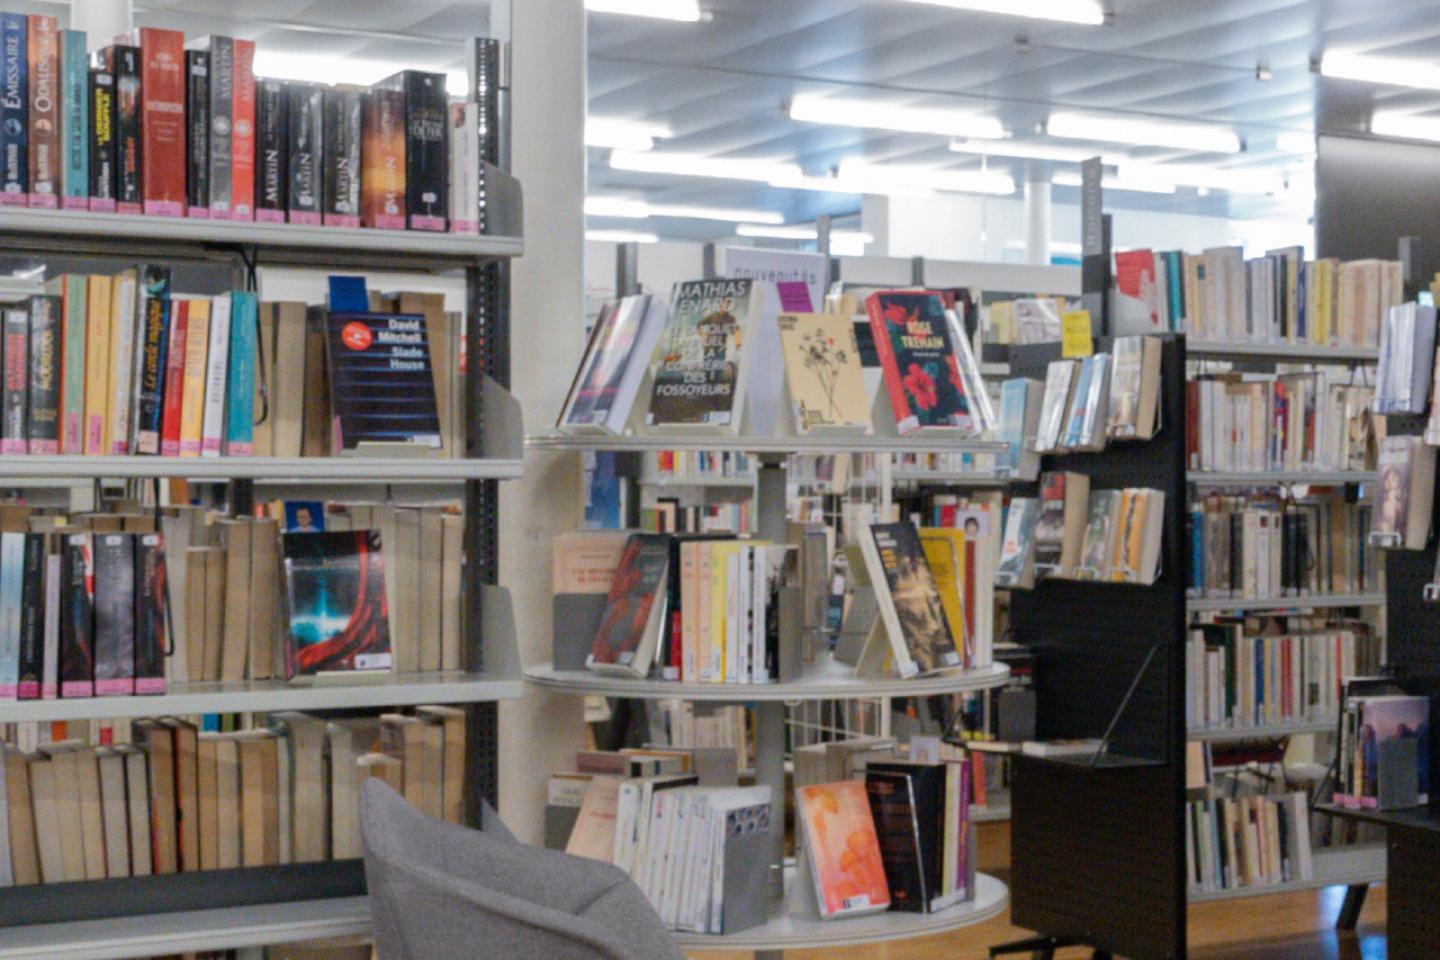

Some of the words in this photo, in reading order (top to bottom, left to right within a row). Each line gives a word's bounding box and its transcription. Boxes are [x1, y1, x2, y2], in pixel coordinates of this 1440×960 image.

[0, 36, 20, 109] ÉMISSAIRE
[265, 150, 278, 202] MARTIN
[680, 282, 747, 299] MATHIAS
[388, 319, 420, 331] David
[378, 331, 422, 342] Mitchell
[391, 346, 423, 358] Slade
[390, 359, 425, 370] House
[684, 372, 707, 384] DES
[656, 384, 731, 396] FOSSOYEURS
